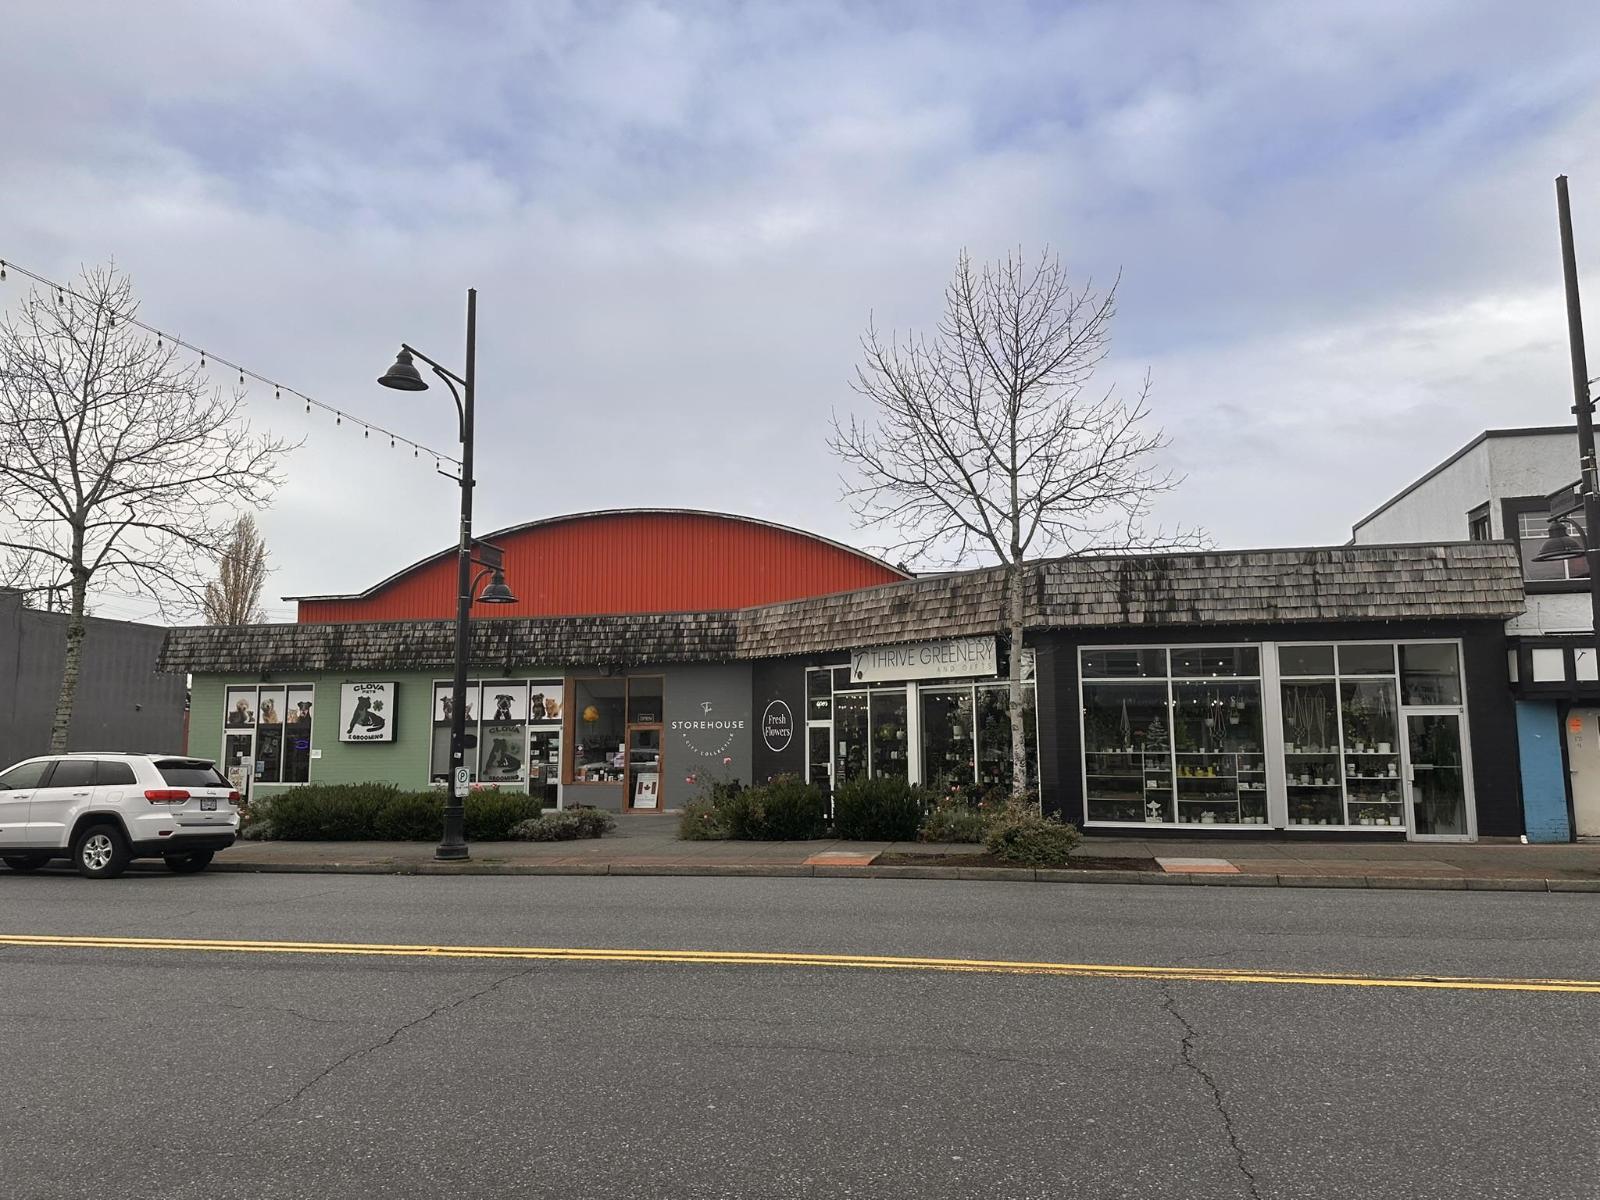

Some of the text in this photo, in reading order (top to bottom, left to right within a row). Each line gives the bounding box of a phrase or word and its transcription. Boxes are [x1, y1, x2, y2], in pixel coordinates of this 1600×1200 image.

[871, 642, 995, 668] THRIVE GREENERY
[937, 662, 993, 673] AND GIFTS
[353, 683, 385, 692] CLOVA
[768, 713, 786, 725] Fresh
[489, 726, 520, 734] CLOVA
[671, 720, 745, 730] STOREHOUSE
[765, 726, 791, 737] Flowers
